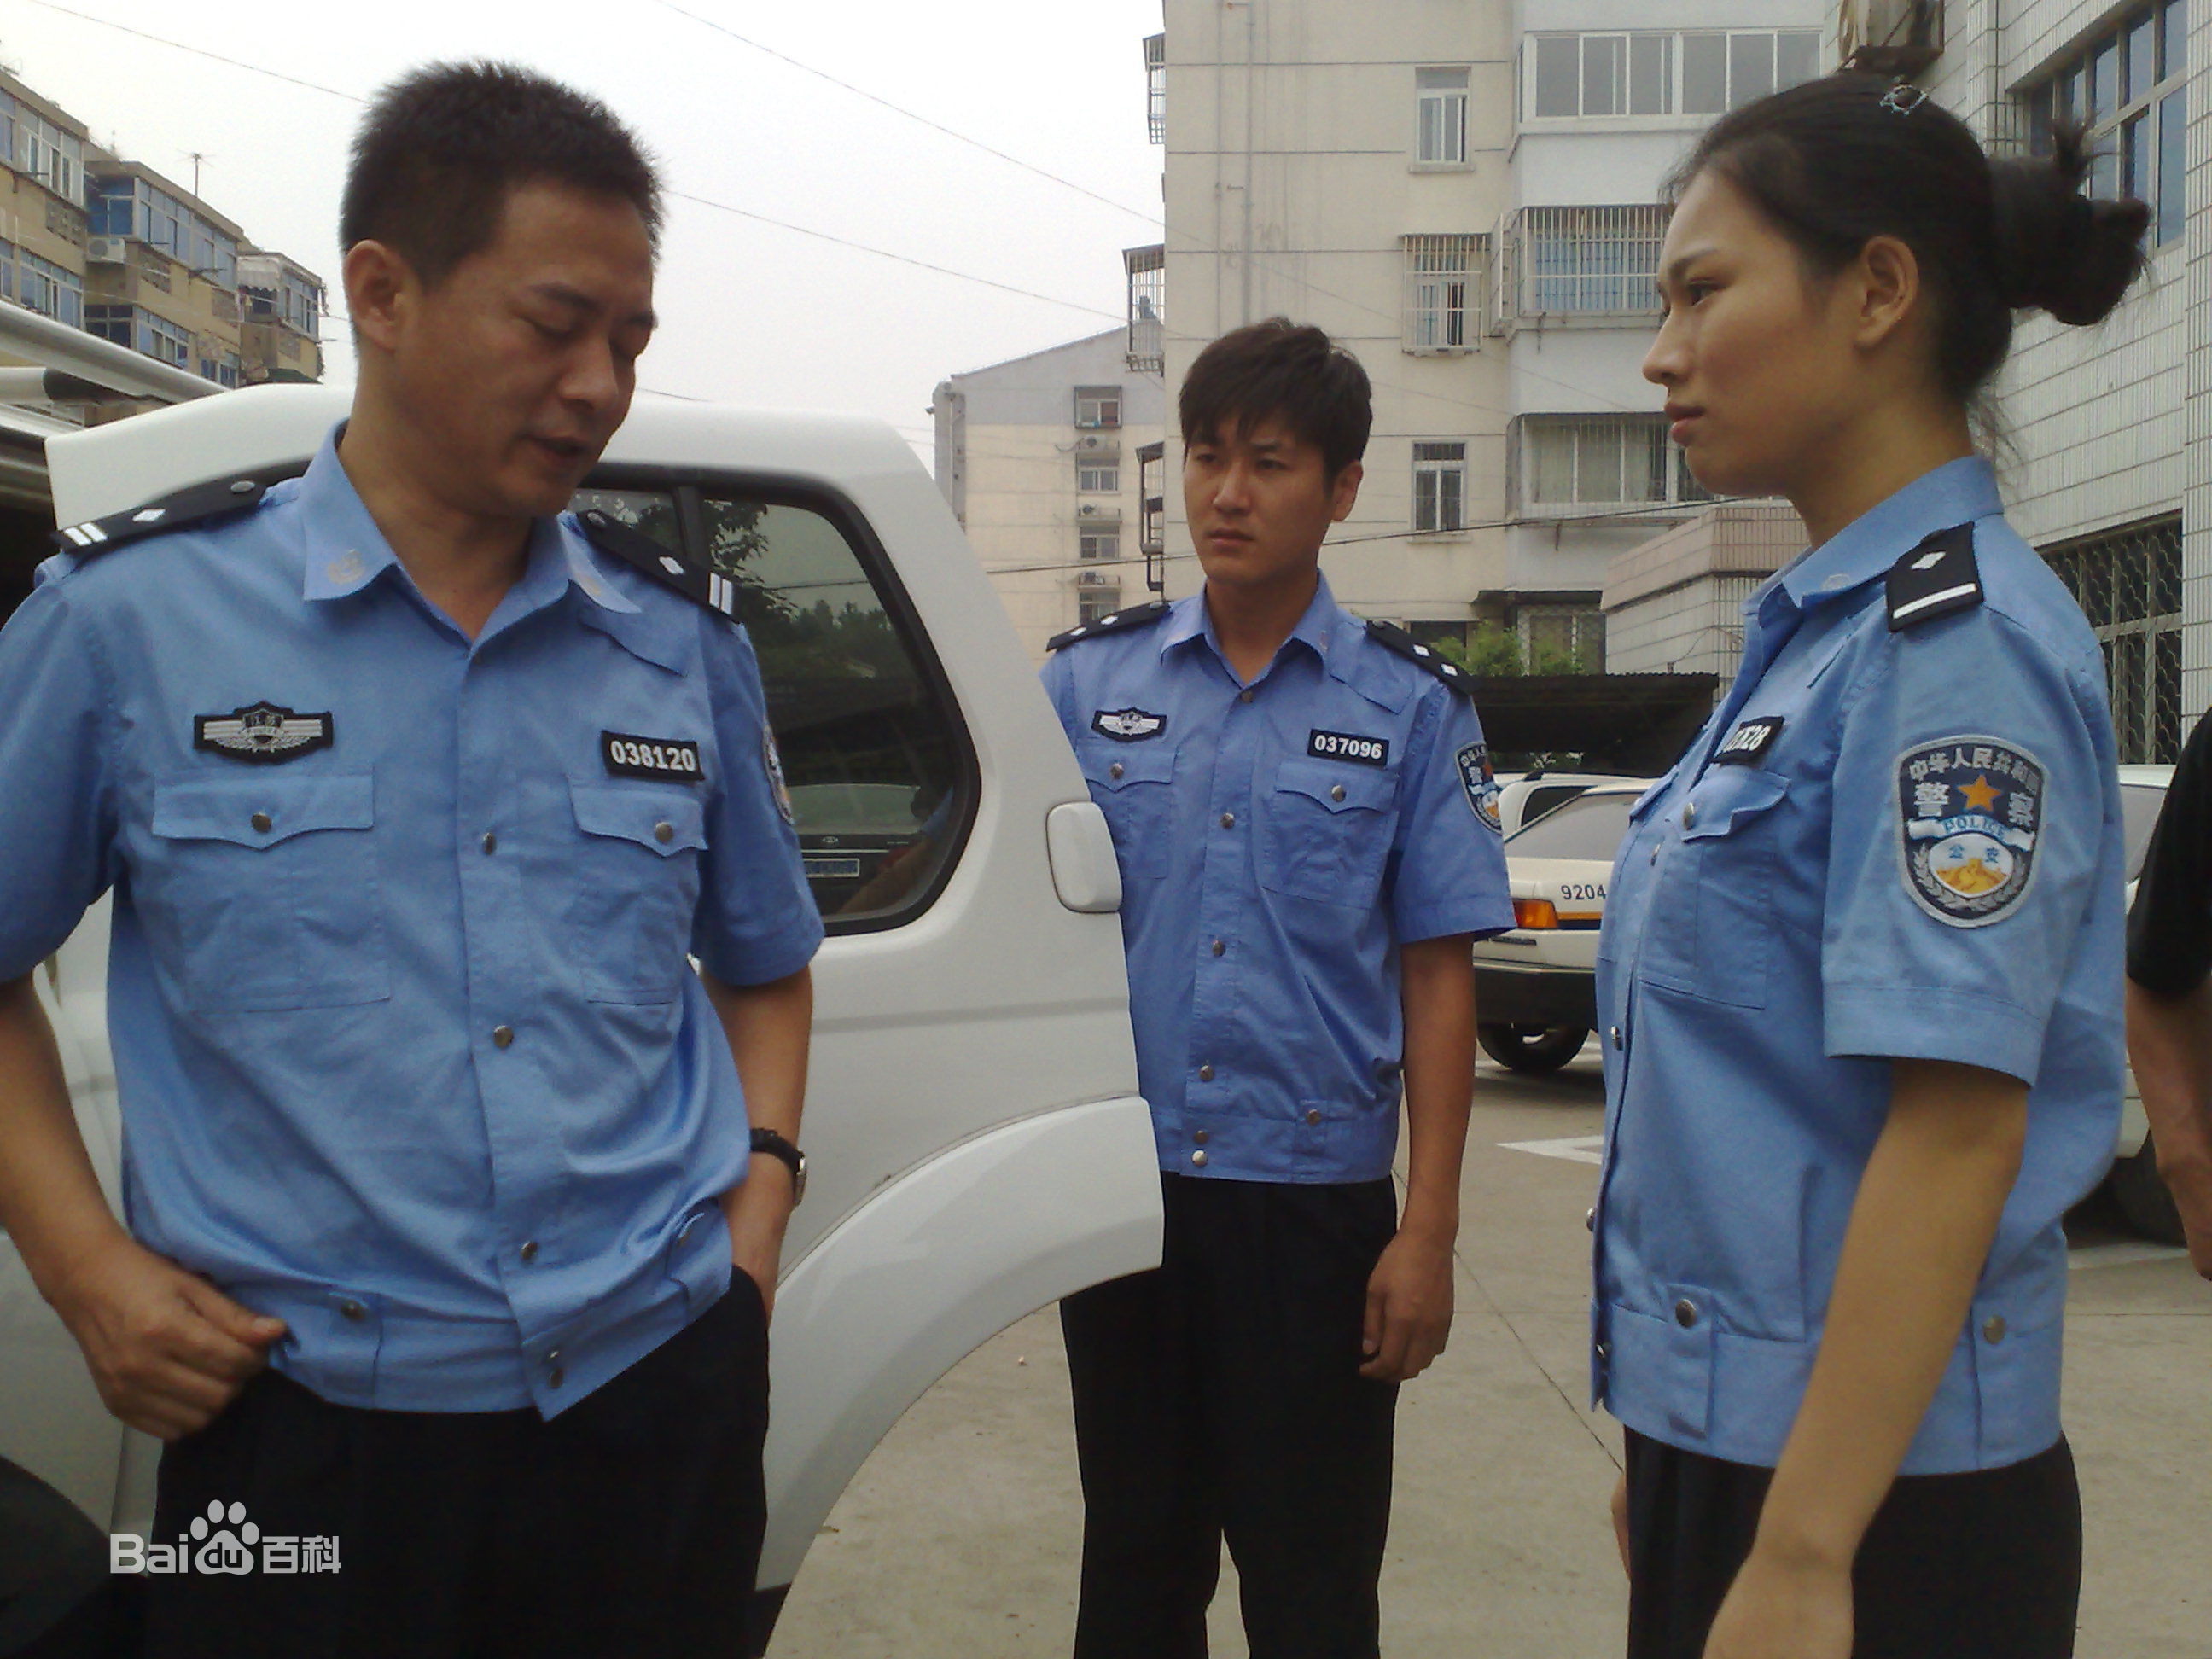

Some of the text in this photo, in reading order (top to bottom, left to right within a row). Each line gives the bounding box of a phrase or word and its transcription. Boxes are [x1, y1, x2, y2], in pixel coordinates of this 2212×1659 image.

[609, 740, 696, 772] 038120
[1314, 734, 1382, 760] 037096
[1944, 816, 2006, 839] POLICE
[1561, 884, 1607, 900] 9204
